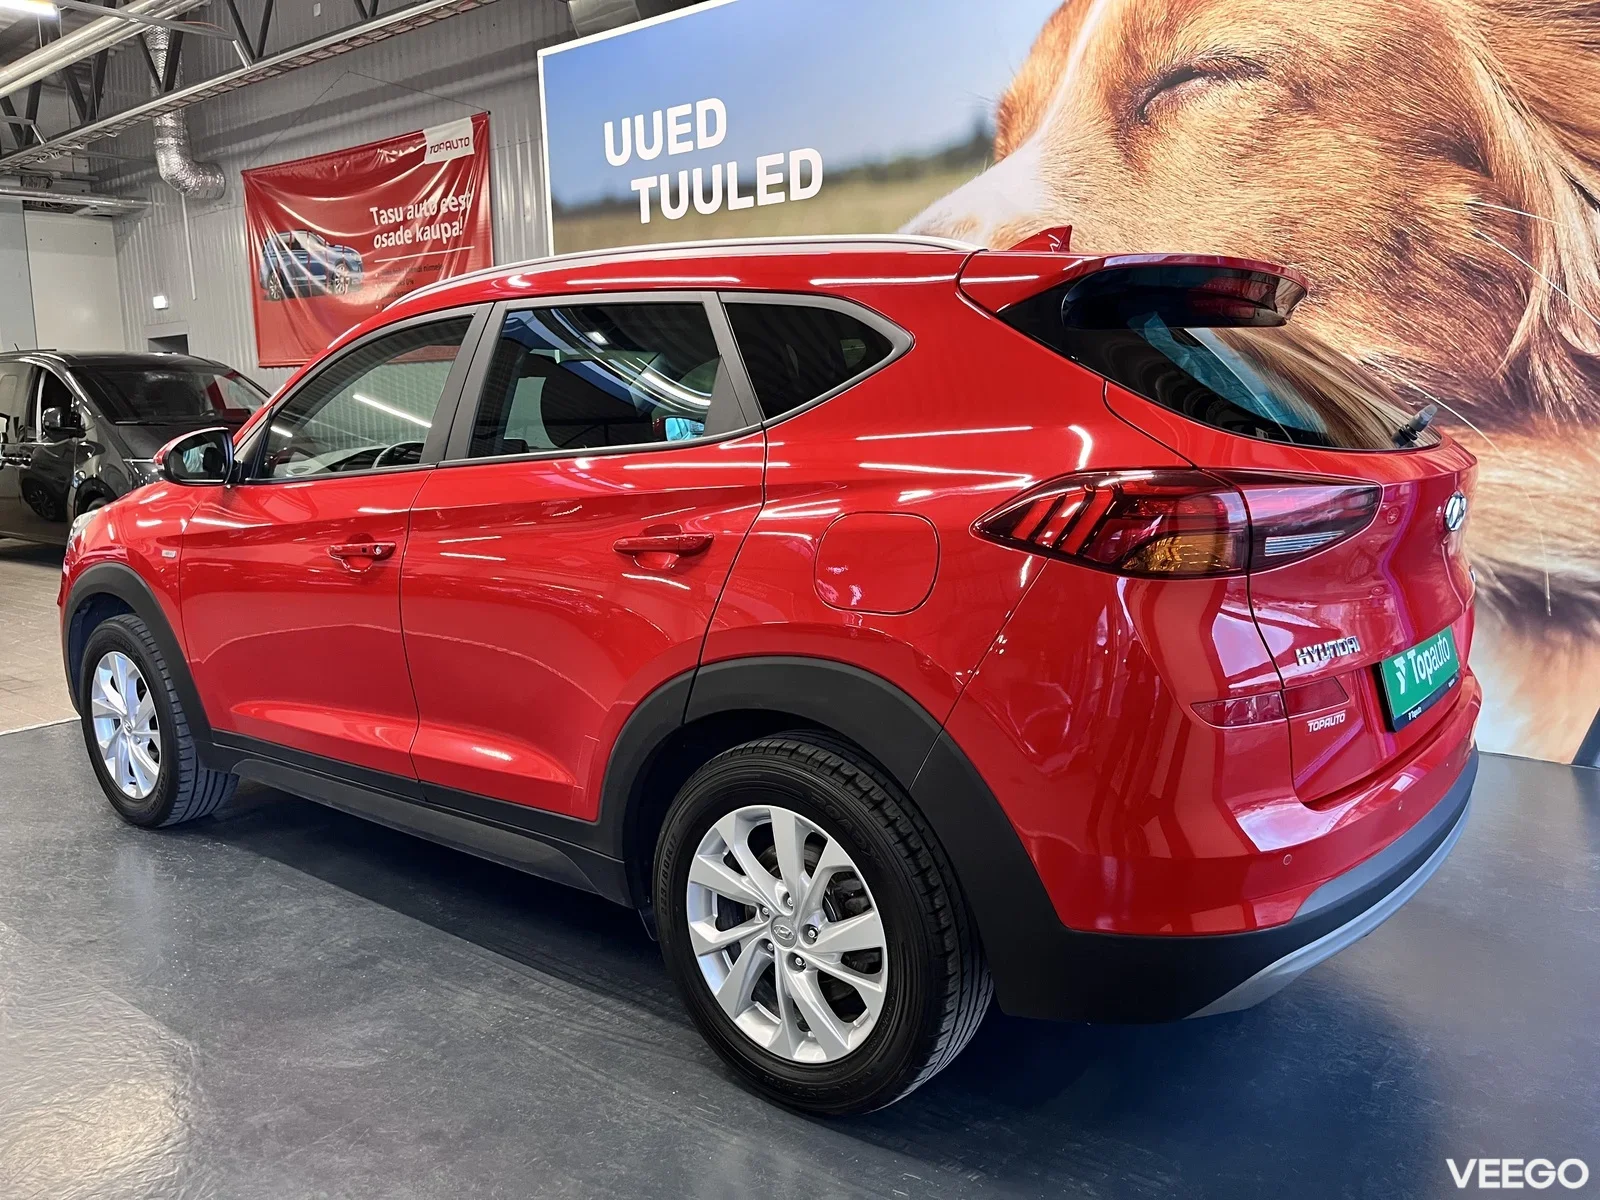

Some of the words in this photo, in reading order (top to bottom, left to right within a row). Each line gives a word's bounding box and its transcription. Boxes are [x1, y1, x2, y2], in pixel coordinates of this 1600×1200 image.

[429, 136, 470, 155] TOPAUTO
[603, 97, 727, 167] UUED
[630, 147, 824, 224] TUULED
[369, 206, 404, 226] Tasu
[406, 199, 438, 220] auto
[440, 190, 472, 214] eest
[373, 225, 413, 249] osade
[415, 216, 463, 245] kaupa!
[1295, 636, 1361, 666] HYUNDAI
[1407, 634, 1450, 686] Topauto
[1307, 712, 1346, 733] TOPAUTO
